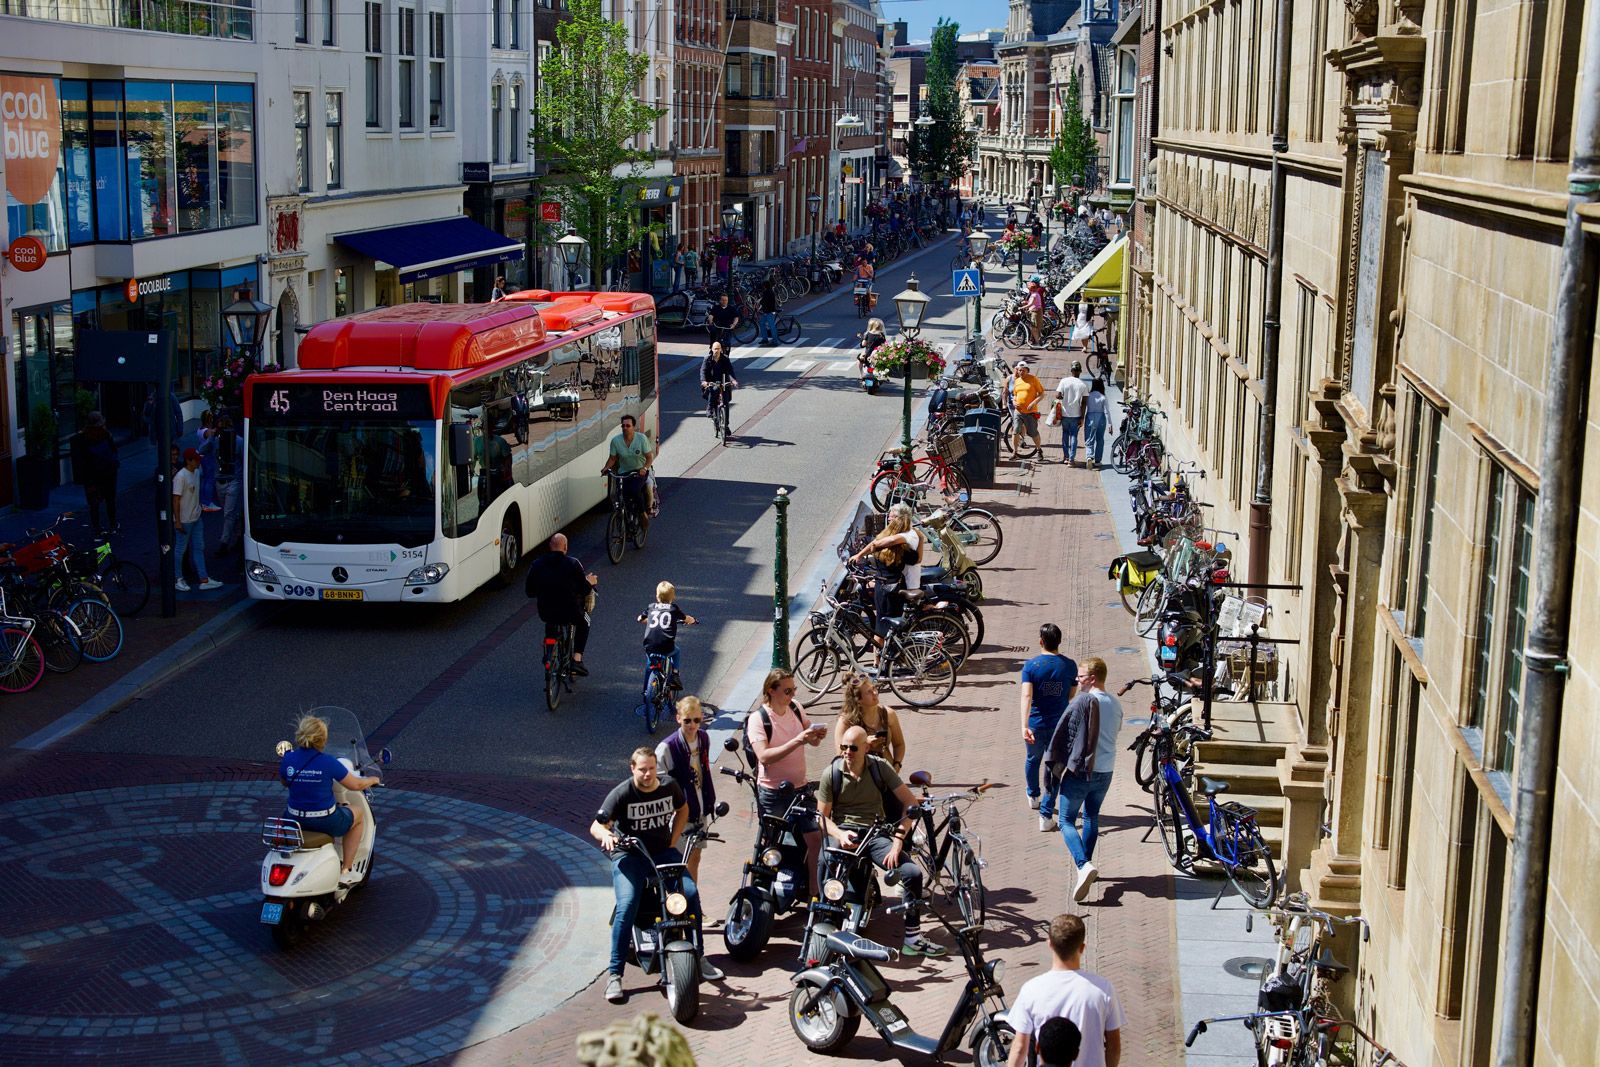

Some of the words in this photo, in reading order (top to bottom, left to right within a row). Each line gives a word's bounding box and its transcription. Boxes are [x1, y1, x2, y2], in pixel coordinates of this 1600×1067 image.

[1, 85, 48, 120] cool
[3, 121, 49, 160] blue
[15, 246, 36, 255] cool
[15, 254, 36, 263] blue
[139, 277, 171, 295] COOLBLUE
[270, 390, 290, 413] 45
[323, 391, 353, 400] Den
[359, 391, 398, 401] Haag
[323, 401, 398, 412] Centraal
[402, 550, 423, 559] 5154
[325, 590, 361, 599] 68-BNN-3
[649, 611, 672, 629] 30
[630, 799, 671, 817] TOMMY
